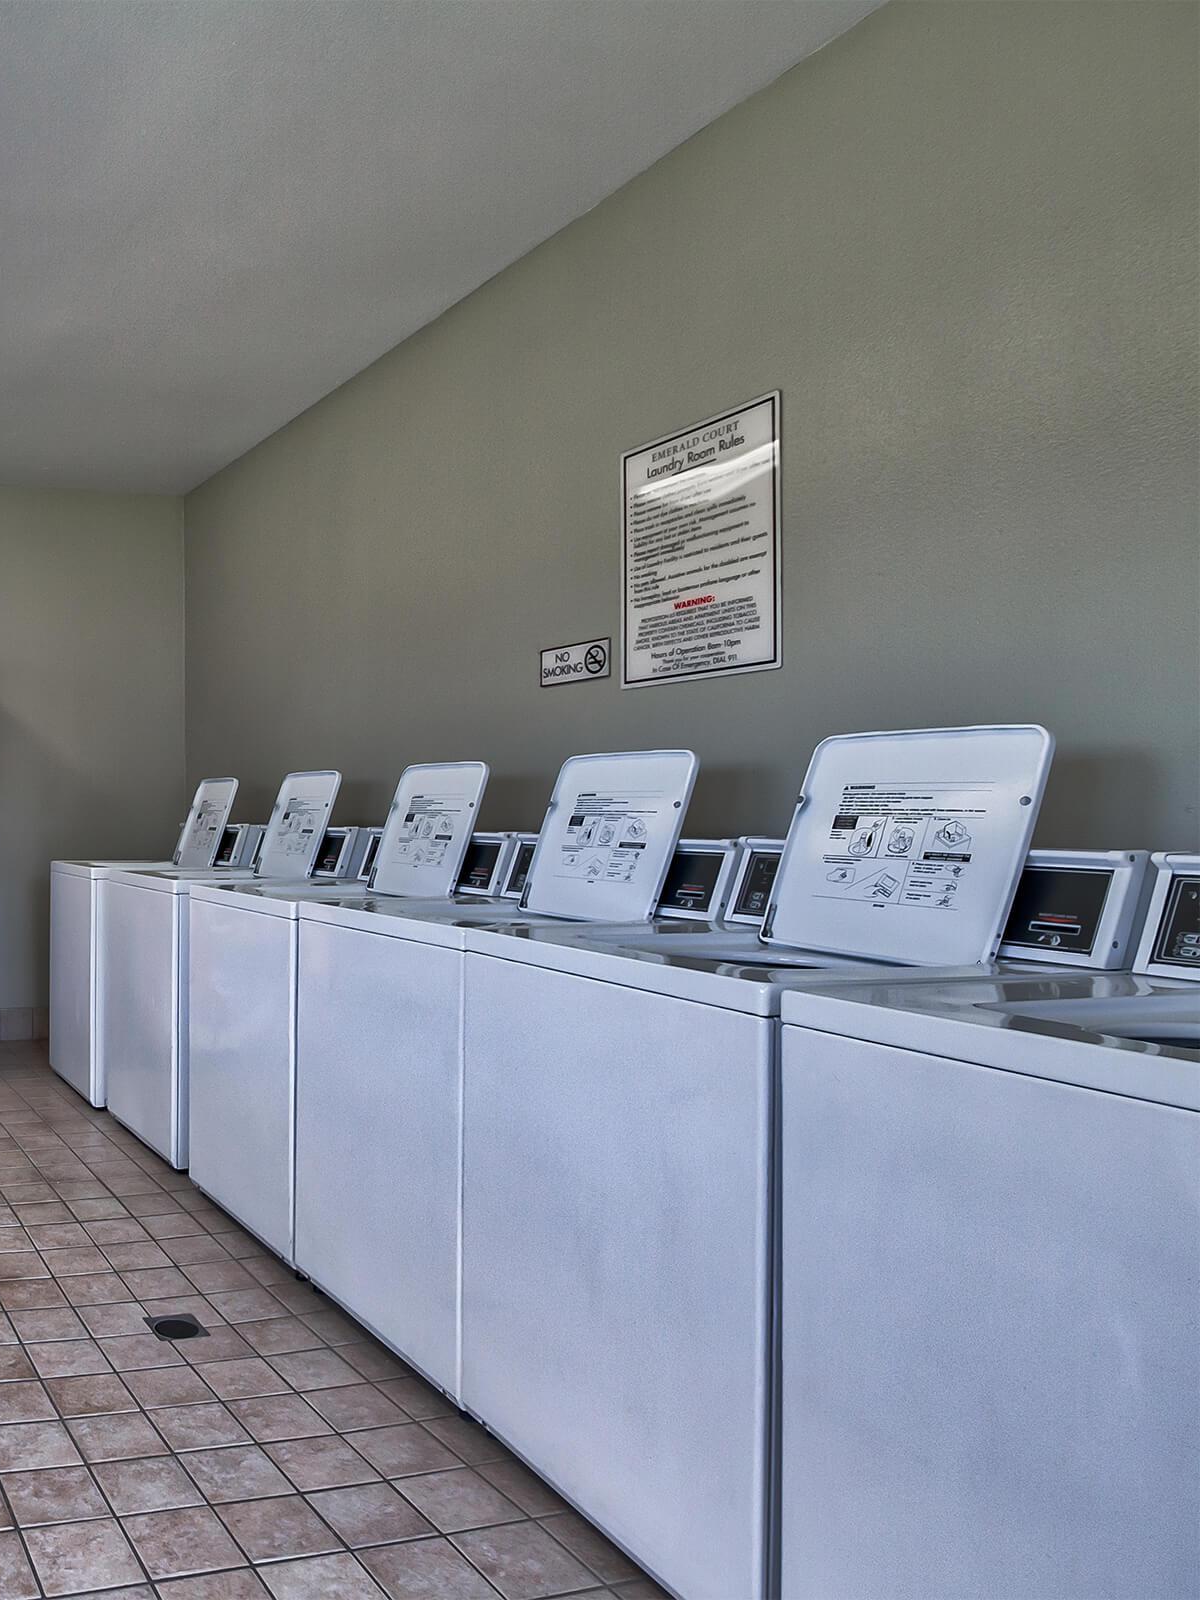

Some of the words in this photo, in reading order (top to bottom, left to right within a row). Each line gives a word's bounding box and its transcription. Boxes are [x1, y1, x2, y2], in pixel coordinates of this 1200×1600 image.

[651, 437, 699, 462] EMERALD
[702, 420, 739, 443] COURT
[647, 456, 684, 478] Laundry
[687, 447, 715, 463] Room
[719, 433, 745, 452] Rules
[673, 595, 716, 610] WARNING:
[555, 651, 570, 664] NO
[675, 645, 706, 656] Operation
[543, 661, 583, 678] SMOKING
